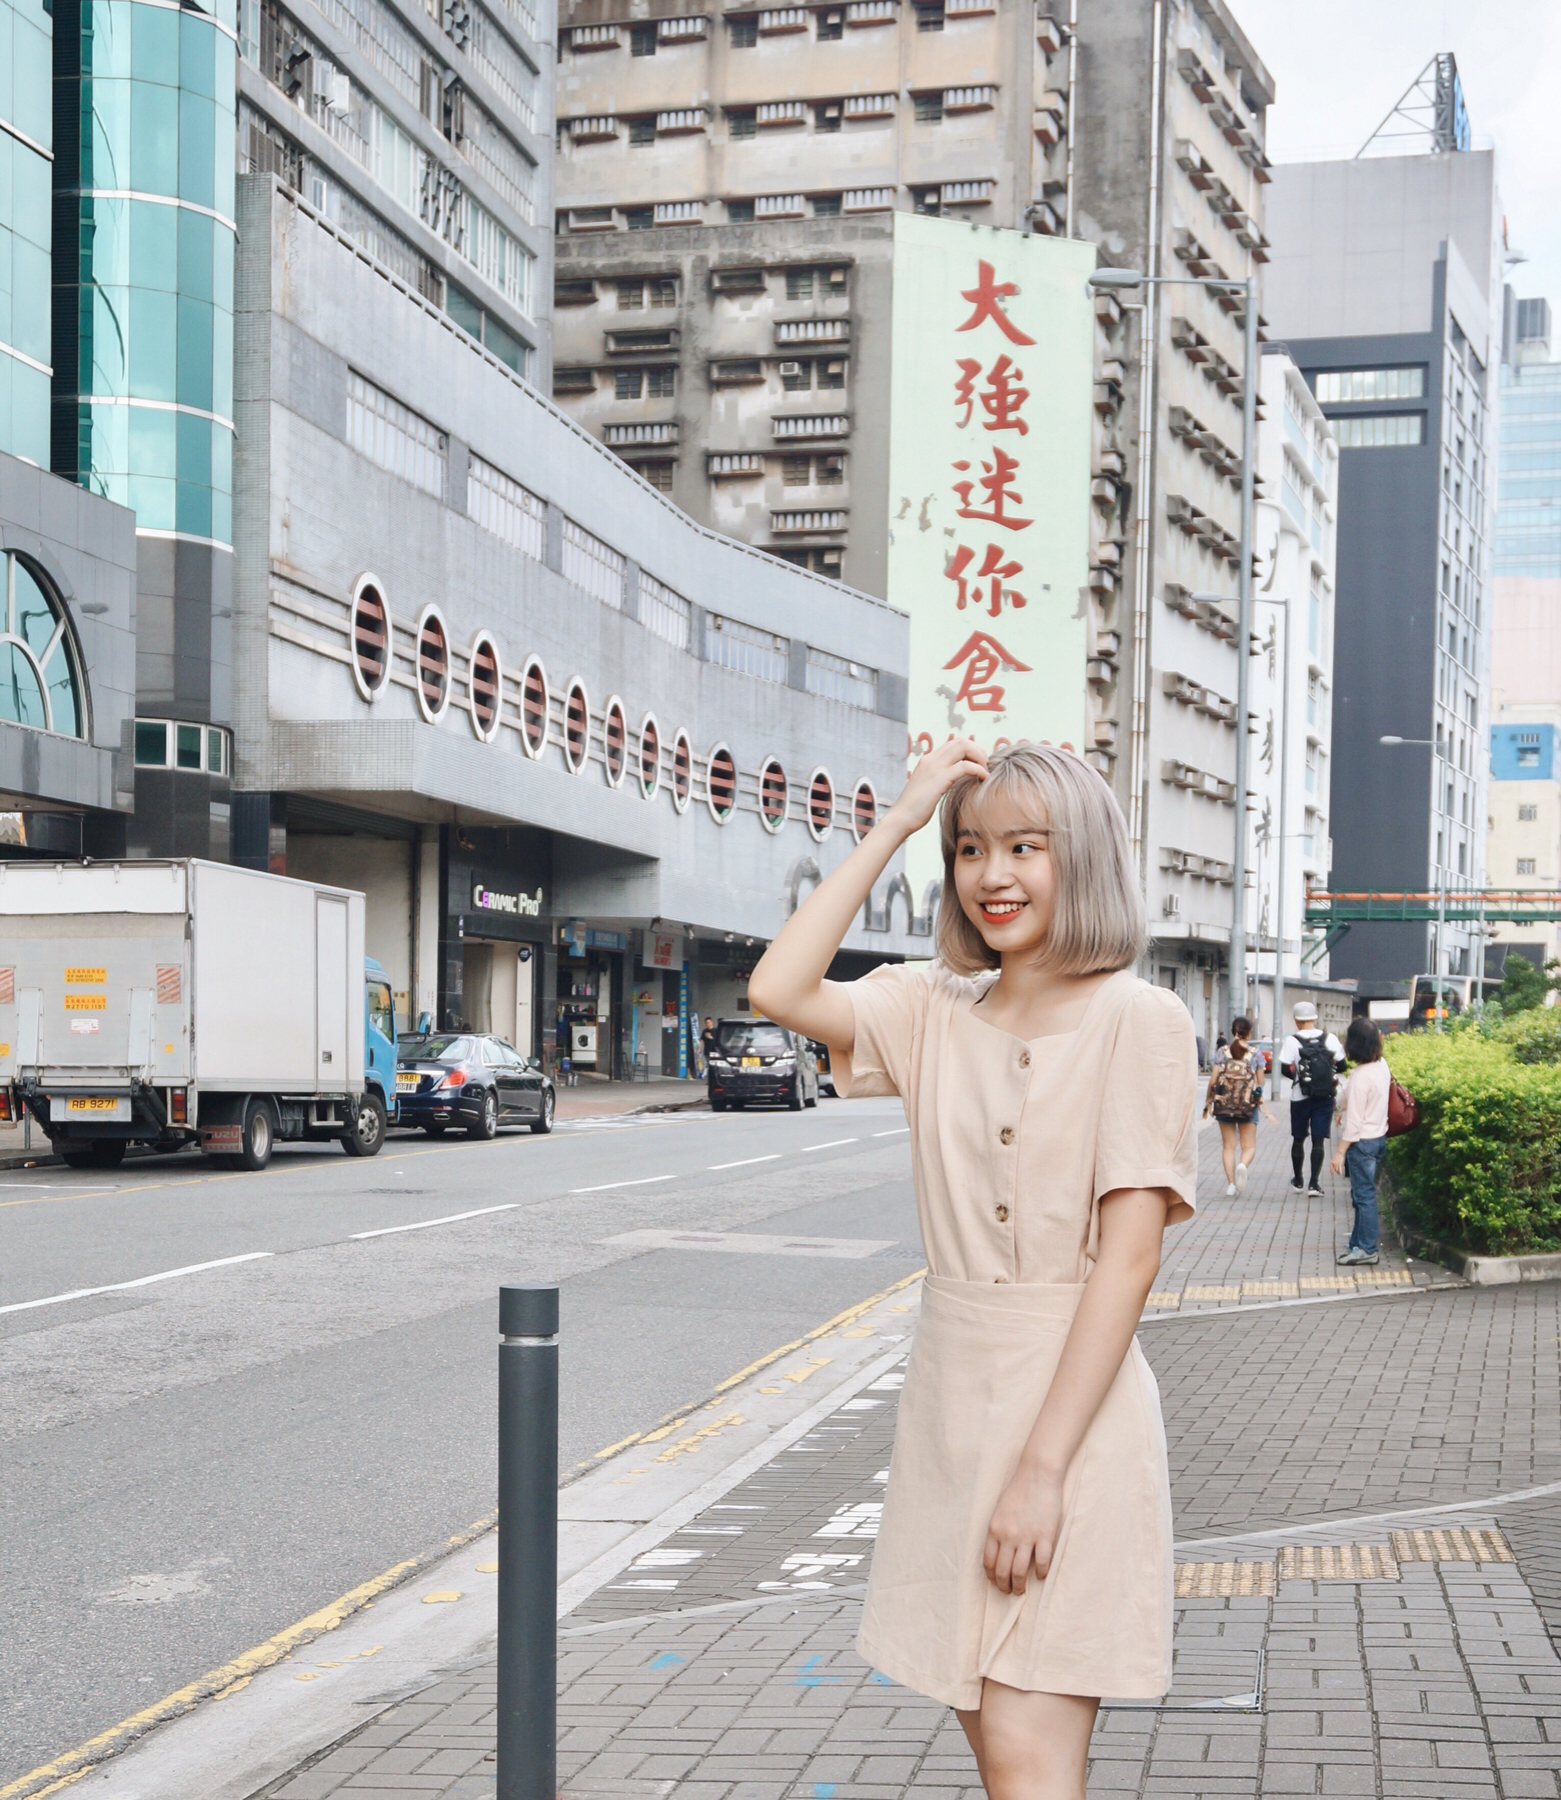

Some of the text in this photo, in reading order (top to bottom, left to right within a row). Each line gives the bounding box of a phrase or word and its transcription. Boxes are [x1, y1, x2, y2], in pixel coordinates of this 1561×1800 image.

[944, 258, 1037, 713] 大強迷你倉
[474, 885, 517, 913] CERAMIC
[72, 1099, 115, 1109] RB 9271
